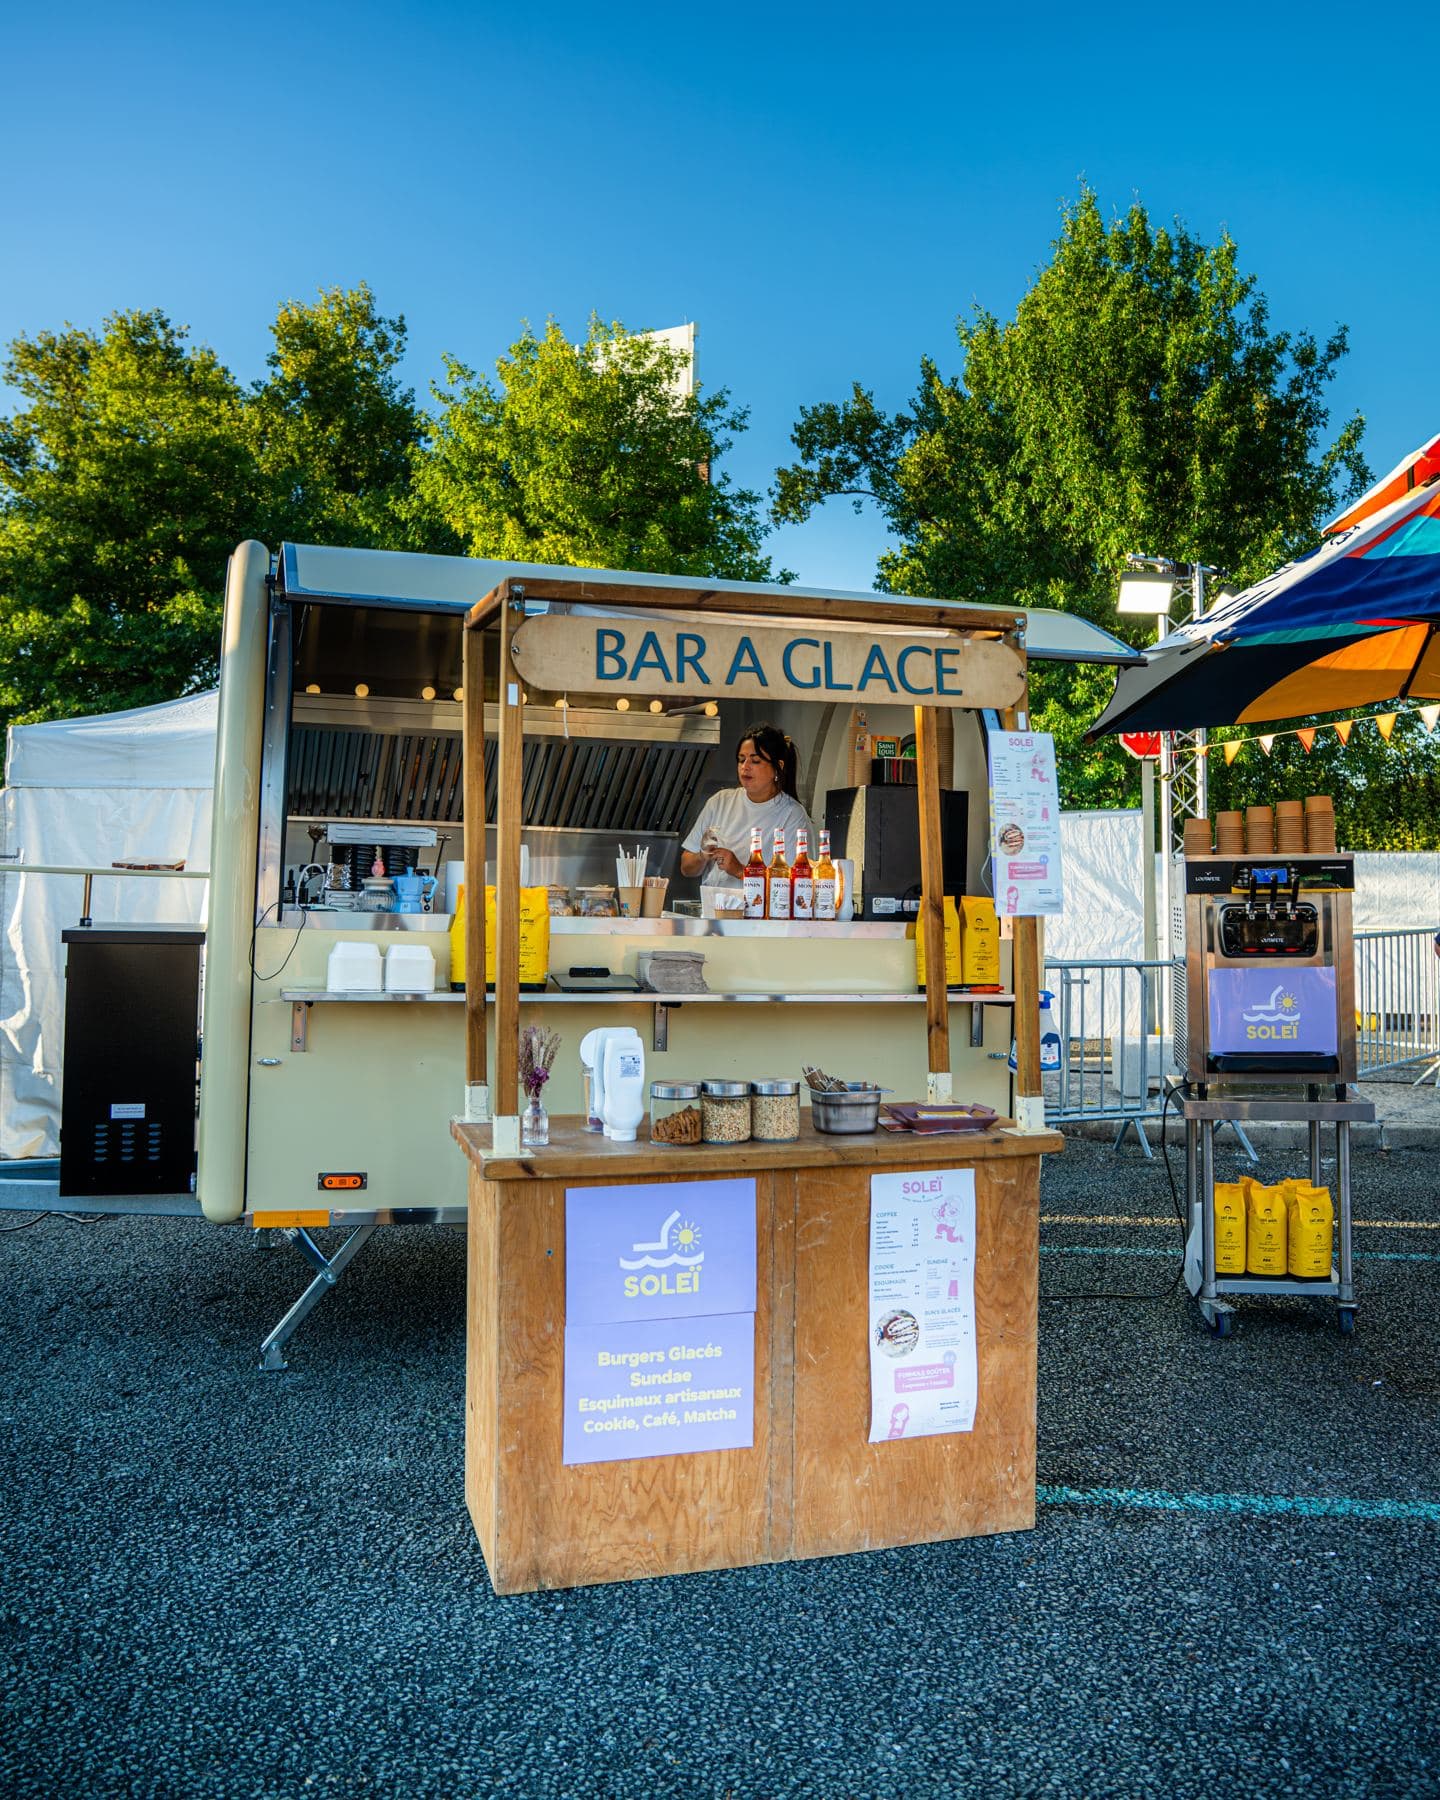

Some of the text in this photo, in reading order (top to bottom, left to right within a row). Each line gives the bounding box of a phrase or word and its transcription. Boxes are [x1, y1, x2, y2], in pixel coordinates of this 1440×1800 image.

[596, 628, 963, 696] BAR A GLACE
[1247, 1021, 1300, 1040] SOLEÏ
[902, 1176, 943, 1194] SOLEÏ
[624, 1265, 702, 1297] SOLEÏ
[598, 1343, 723, 1367] Burgers Glacés
[630, 1369, 692, 1387] Sundae
[578, 1387, 742, 1413] Esquimaux artisanaux
[583, 1408, 737, 1433] Cookie, Café, Matcha
